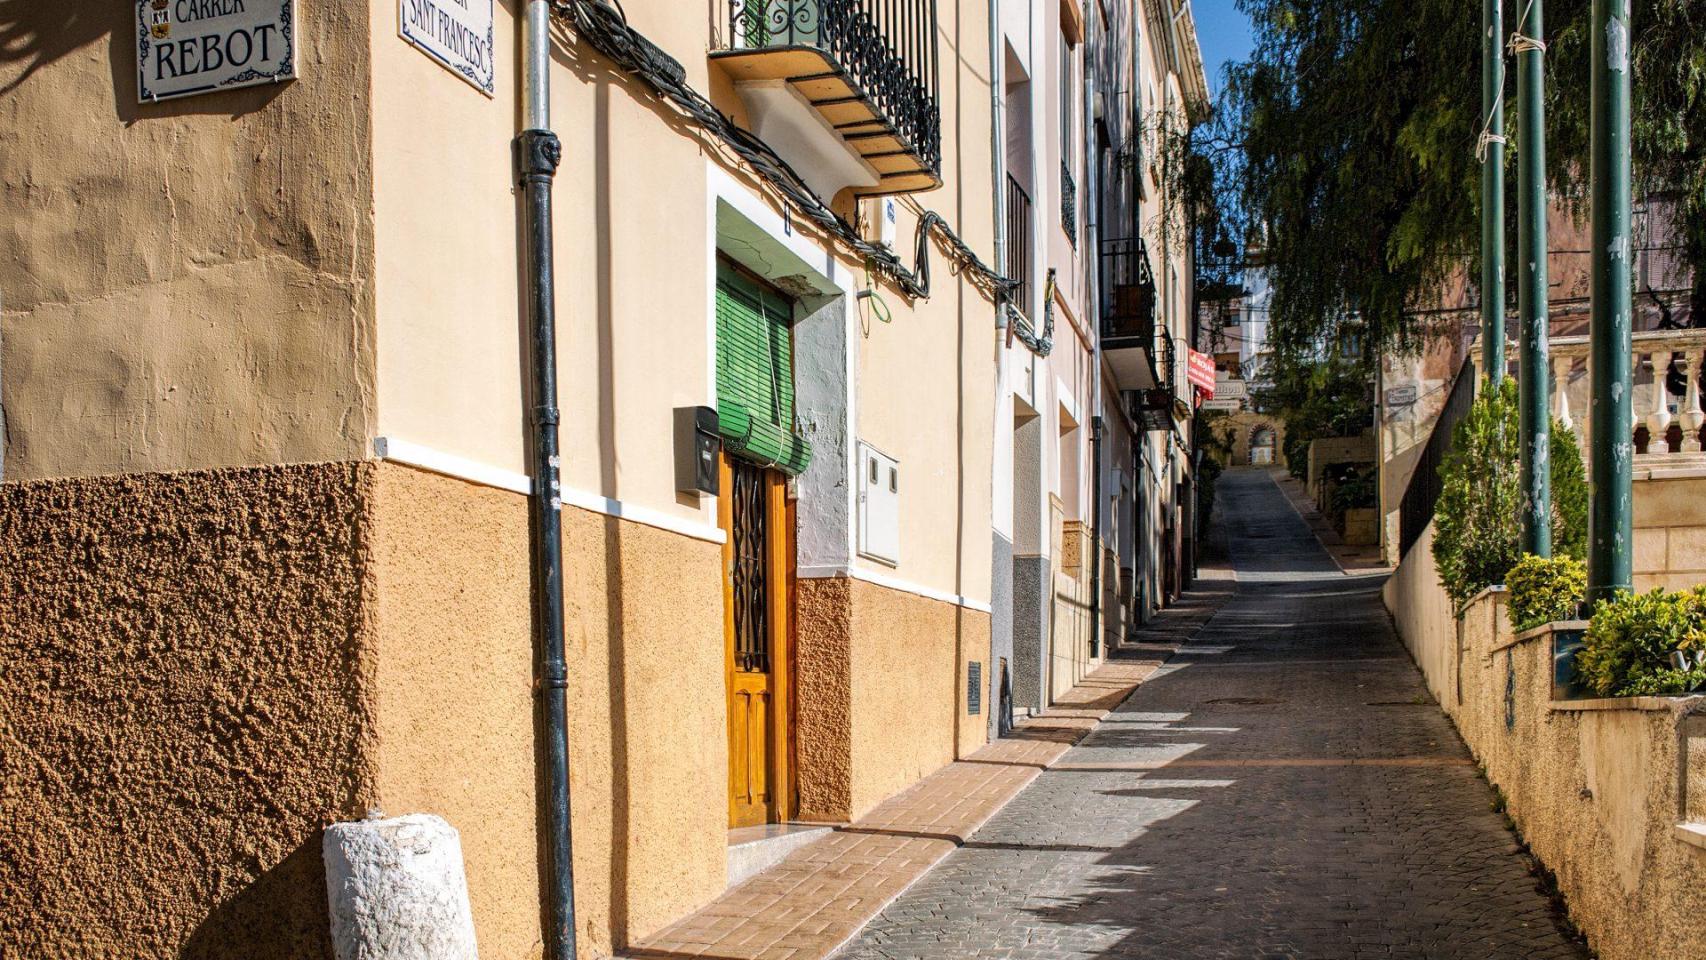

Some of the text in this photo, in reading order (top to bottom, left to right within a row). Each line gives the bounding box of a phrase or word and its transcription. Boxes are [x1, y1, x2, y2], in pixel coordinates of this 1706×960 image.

[154, 23, 277, 81] REBOT
[410, 0, 487, 74] SANT FRANCESC
